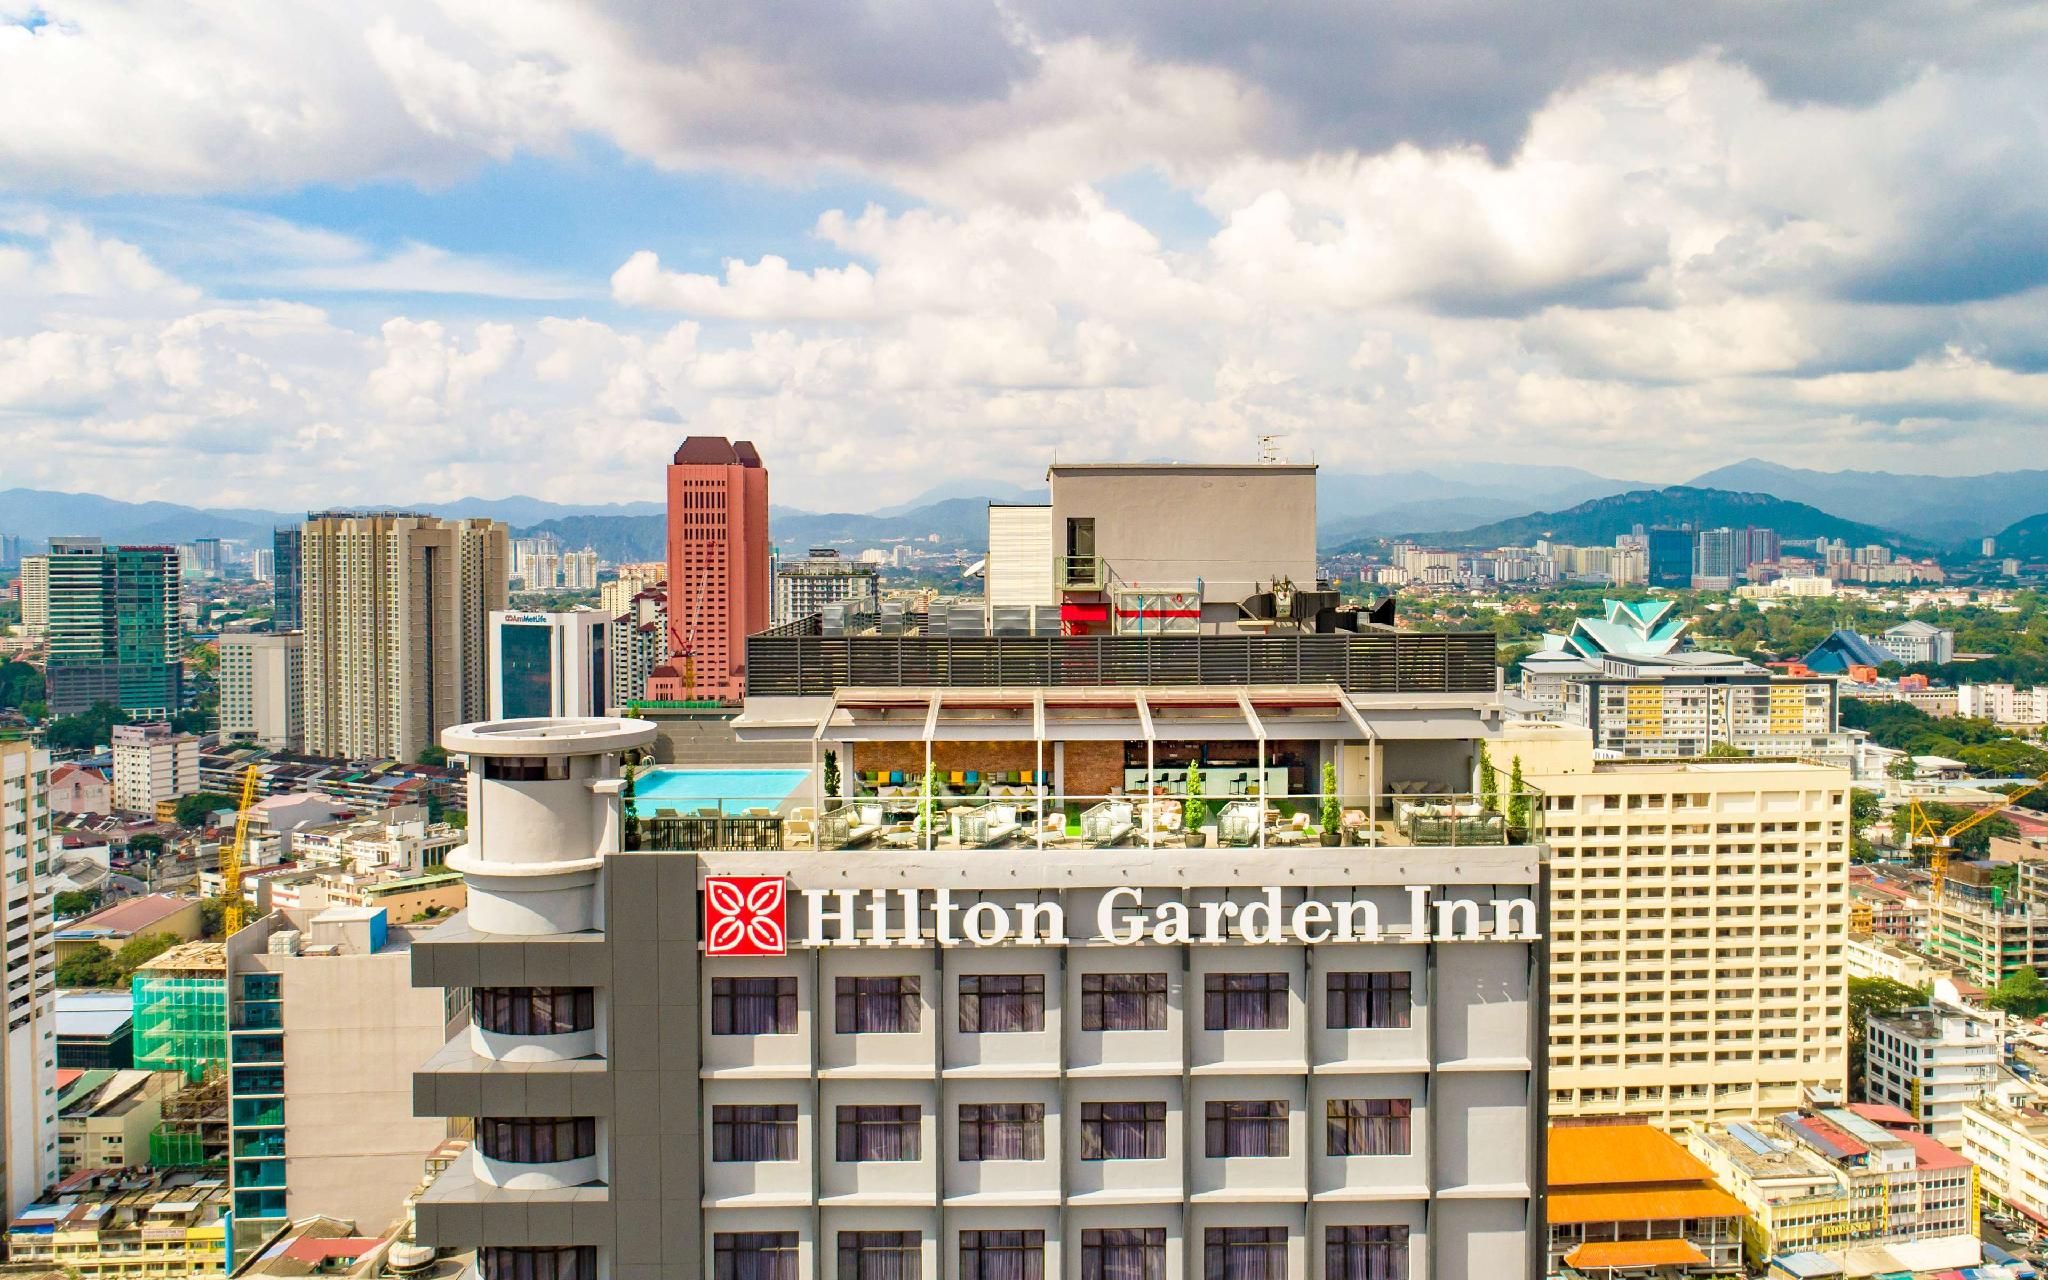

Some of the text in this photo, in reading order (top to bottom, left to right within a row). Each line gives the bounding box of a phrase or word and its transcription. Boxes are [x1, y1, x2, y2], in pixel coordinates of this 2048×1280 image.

[513, 615, 546, 623] AmMetLife
[802, 884, 1543, 946] Hilton Garden Inn
